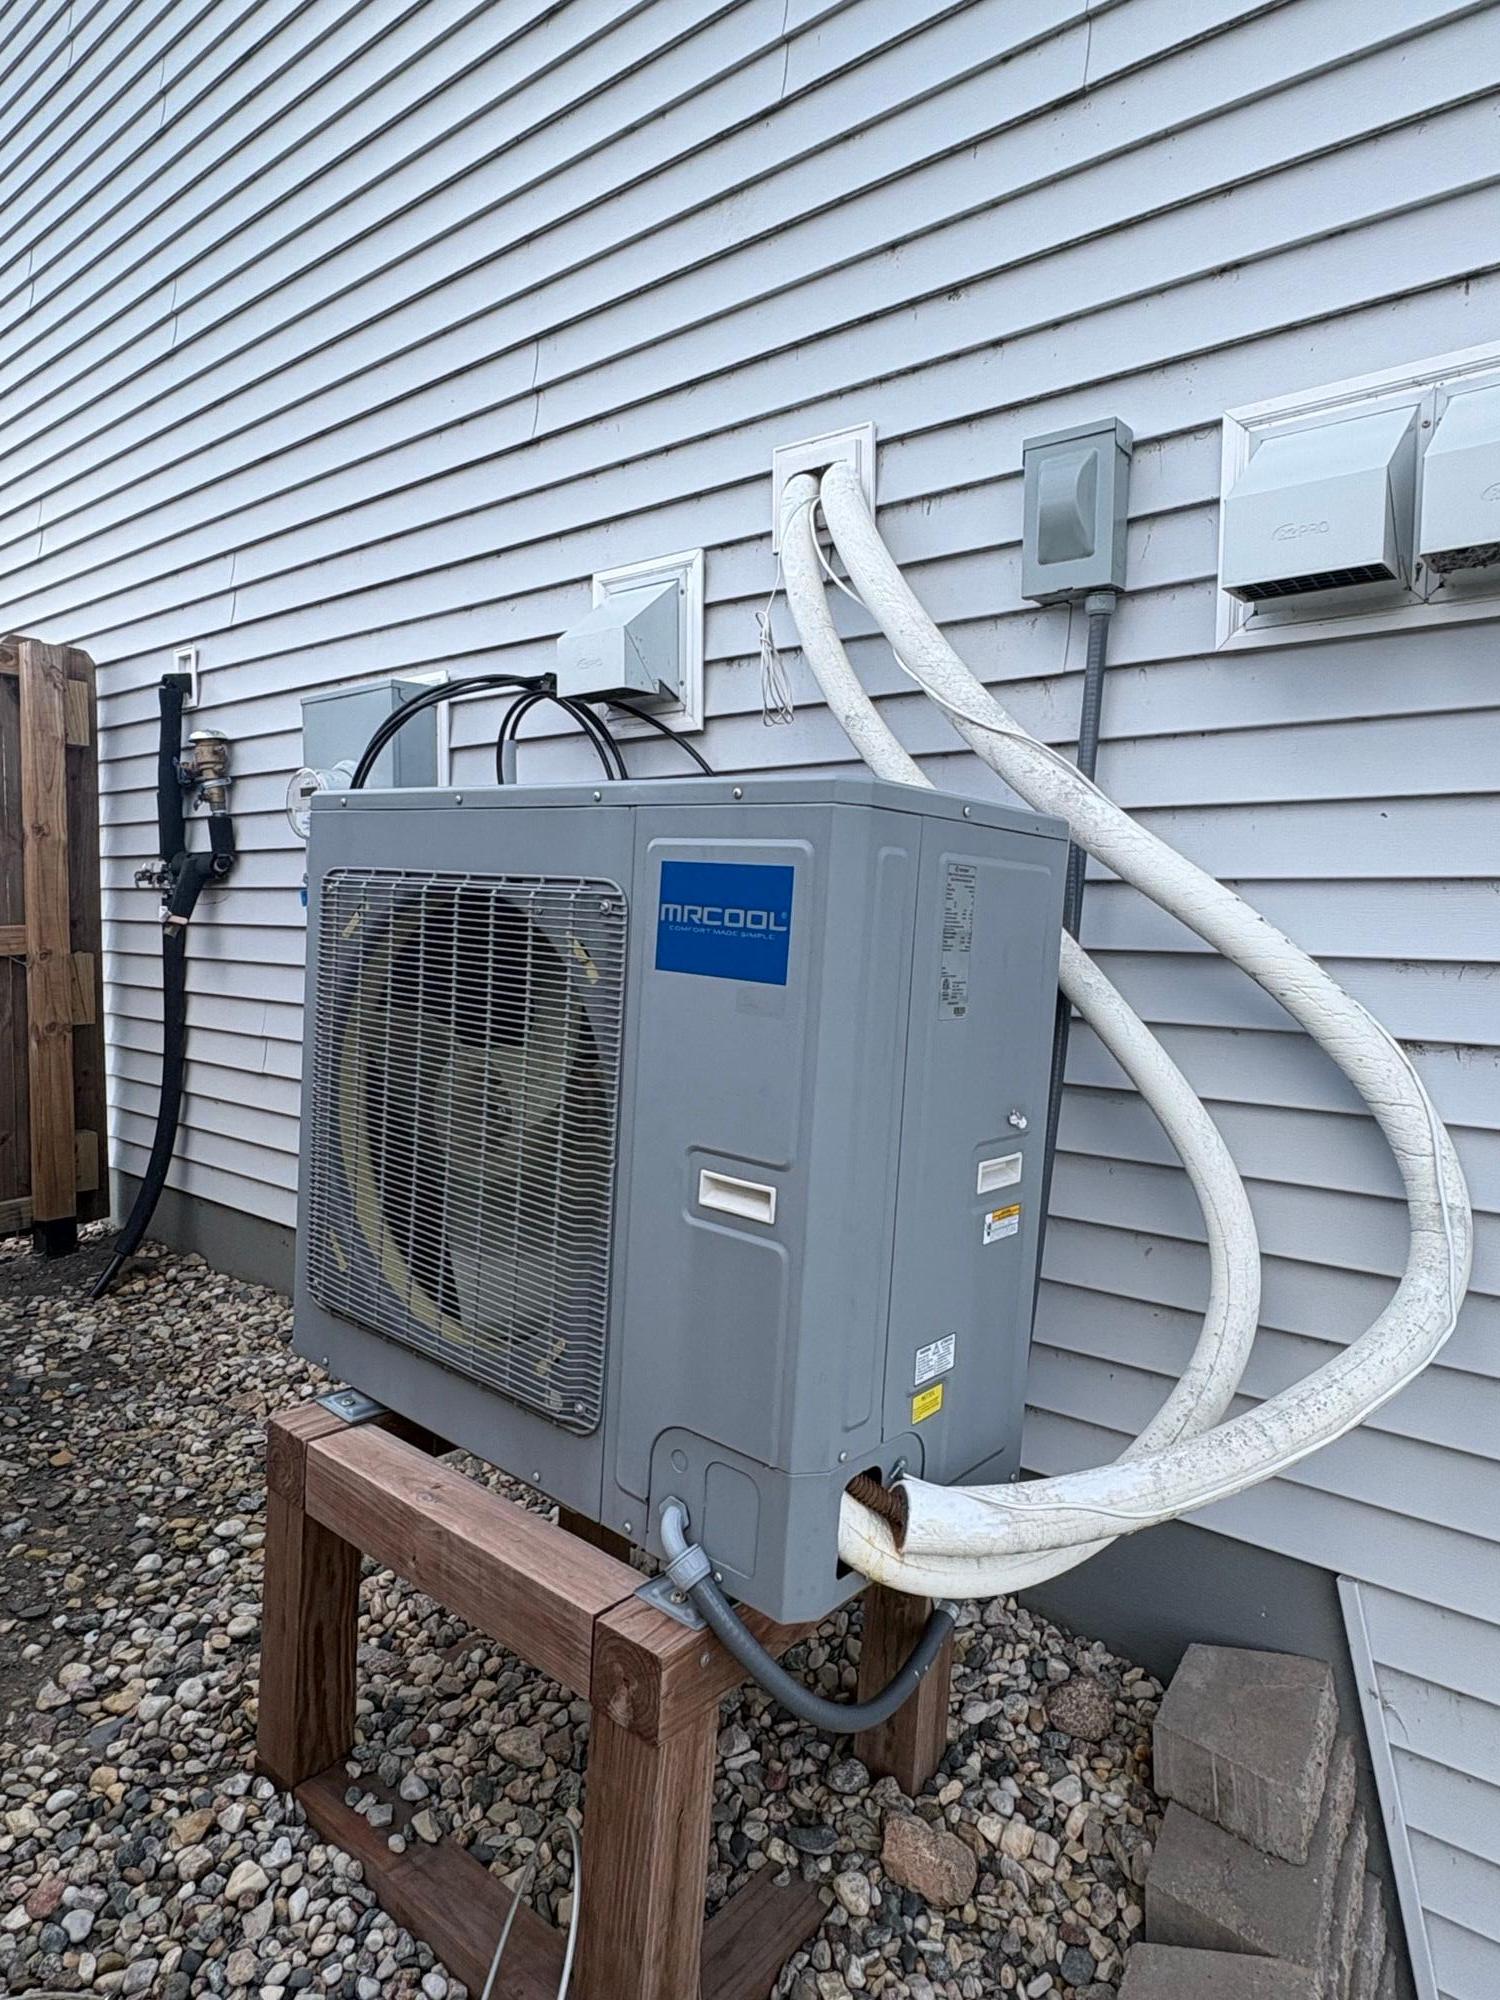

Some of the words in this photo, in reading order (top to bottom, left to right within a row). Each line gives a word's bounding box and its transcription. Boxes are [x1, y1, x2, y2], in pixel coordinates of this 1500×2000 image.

[660, 904, 787, 931] MRCOOL
[668, 925, 710, 935] COMFORT
[713, 929, 738, 937] MADE
[741, 931, 776, 941] SIMPLE
